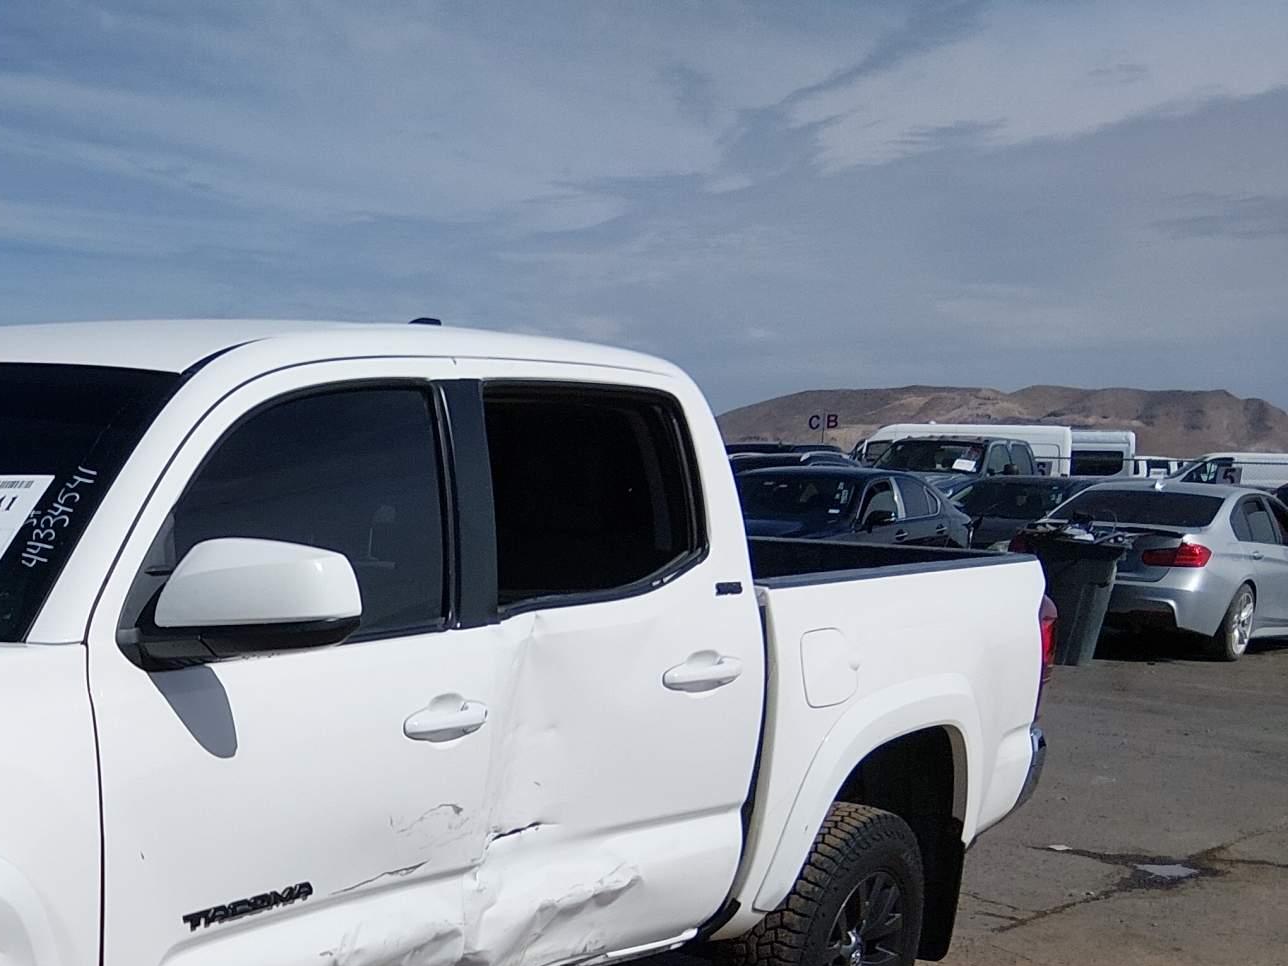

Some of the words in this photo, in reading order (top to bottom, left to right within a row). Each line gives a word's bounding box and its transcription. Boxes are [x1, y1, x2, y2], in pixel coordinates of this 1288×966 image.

[808, 414, 821, 430] C
[826, 414, 838, 429] B
[21, 465, 97, 568] 44334541
[182, 881, 314, 932] TACOMA
